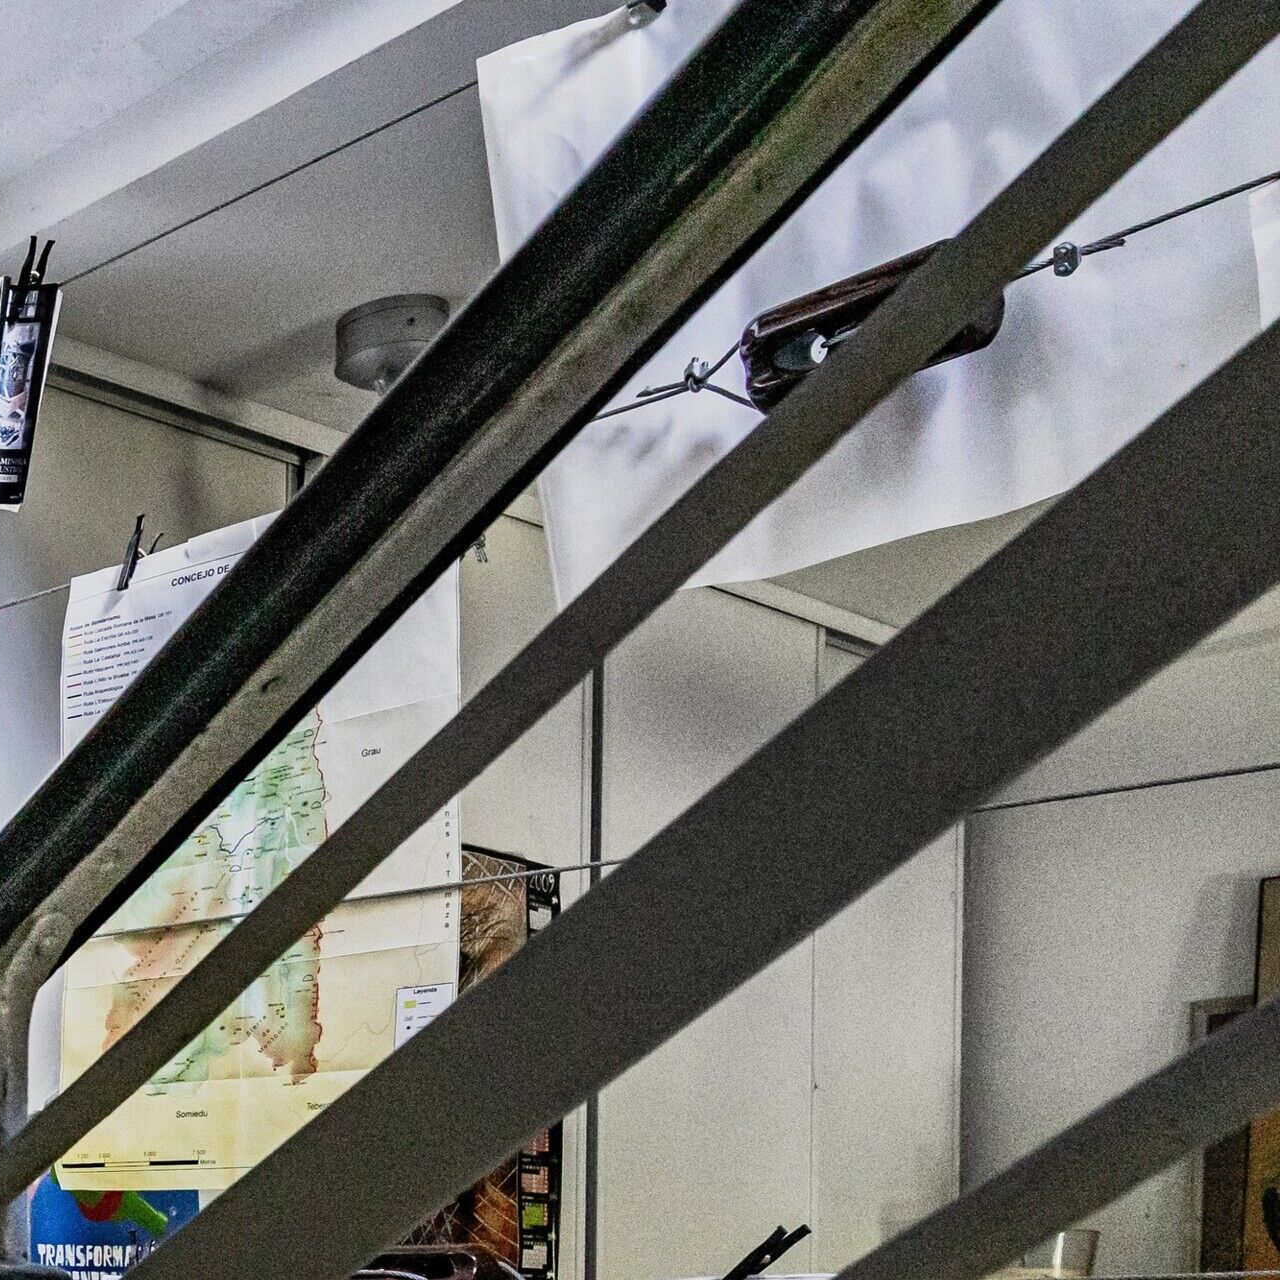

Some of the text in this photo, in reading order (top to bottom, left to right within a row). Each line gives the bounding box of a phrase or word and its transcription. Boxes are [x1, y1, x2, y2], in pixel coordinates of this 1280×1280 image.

[171, 564, 231, 587] CONCEJO DE
[361, 746, 382, 758] Grau
